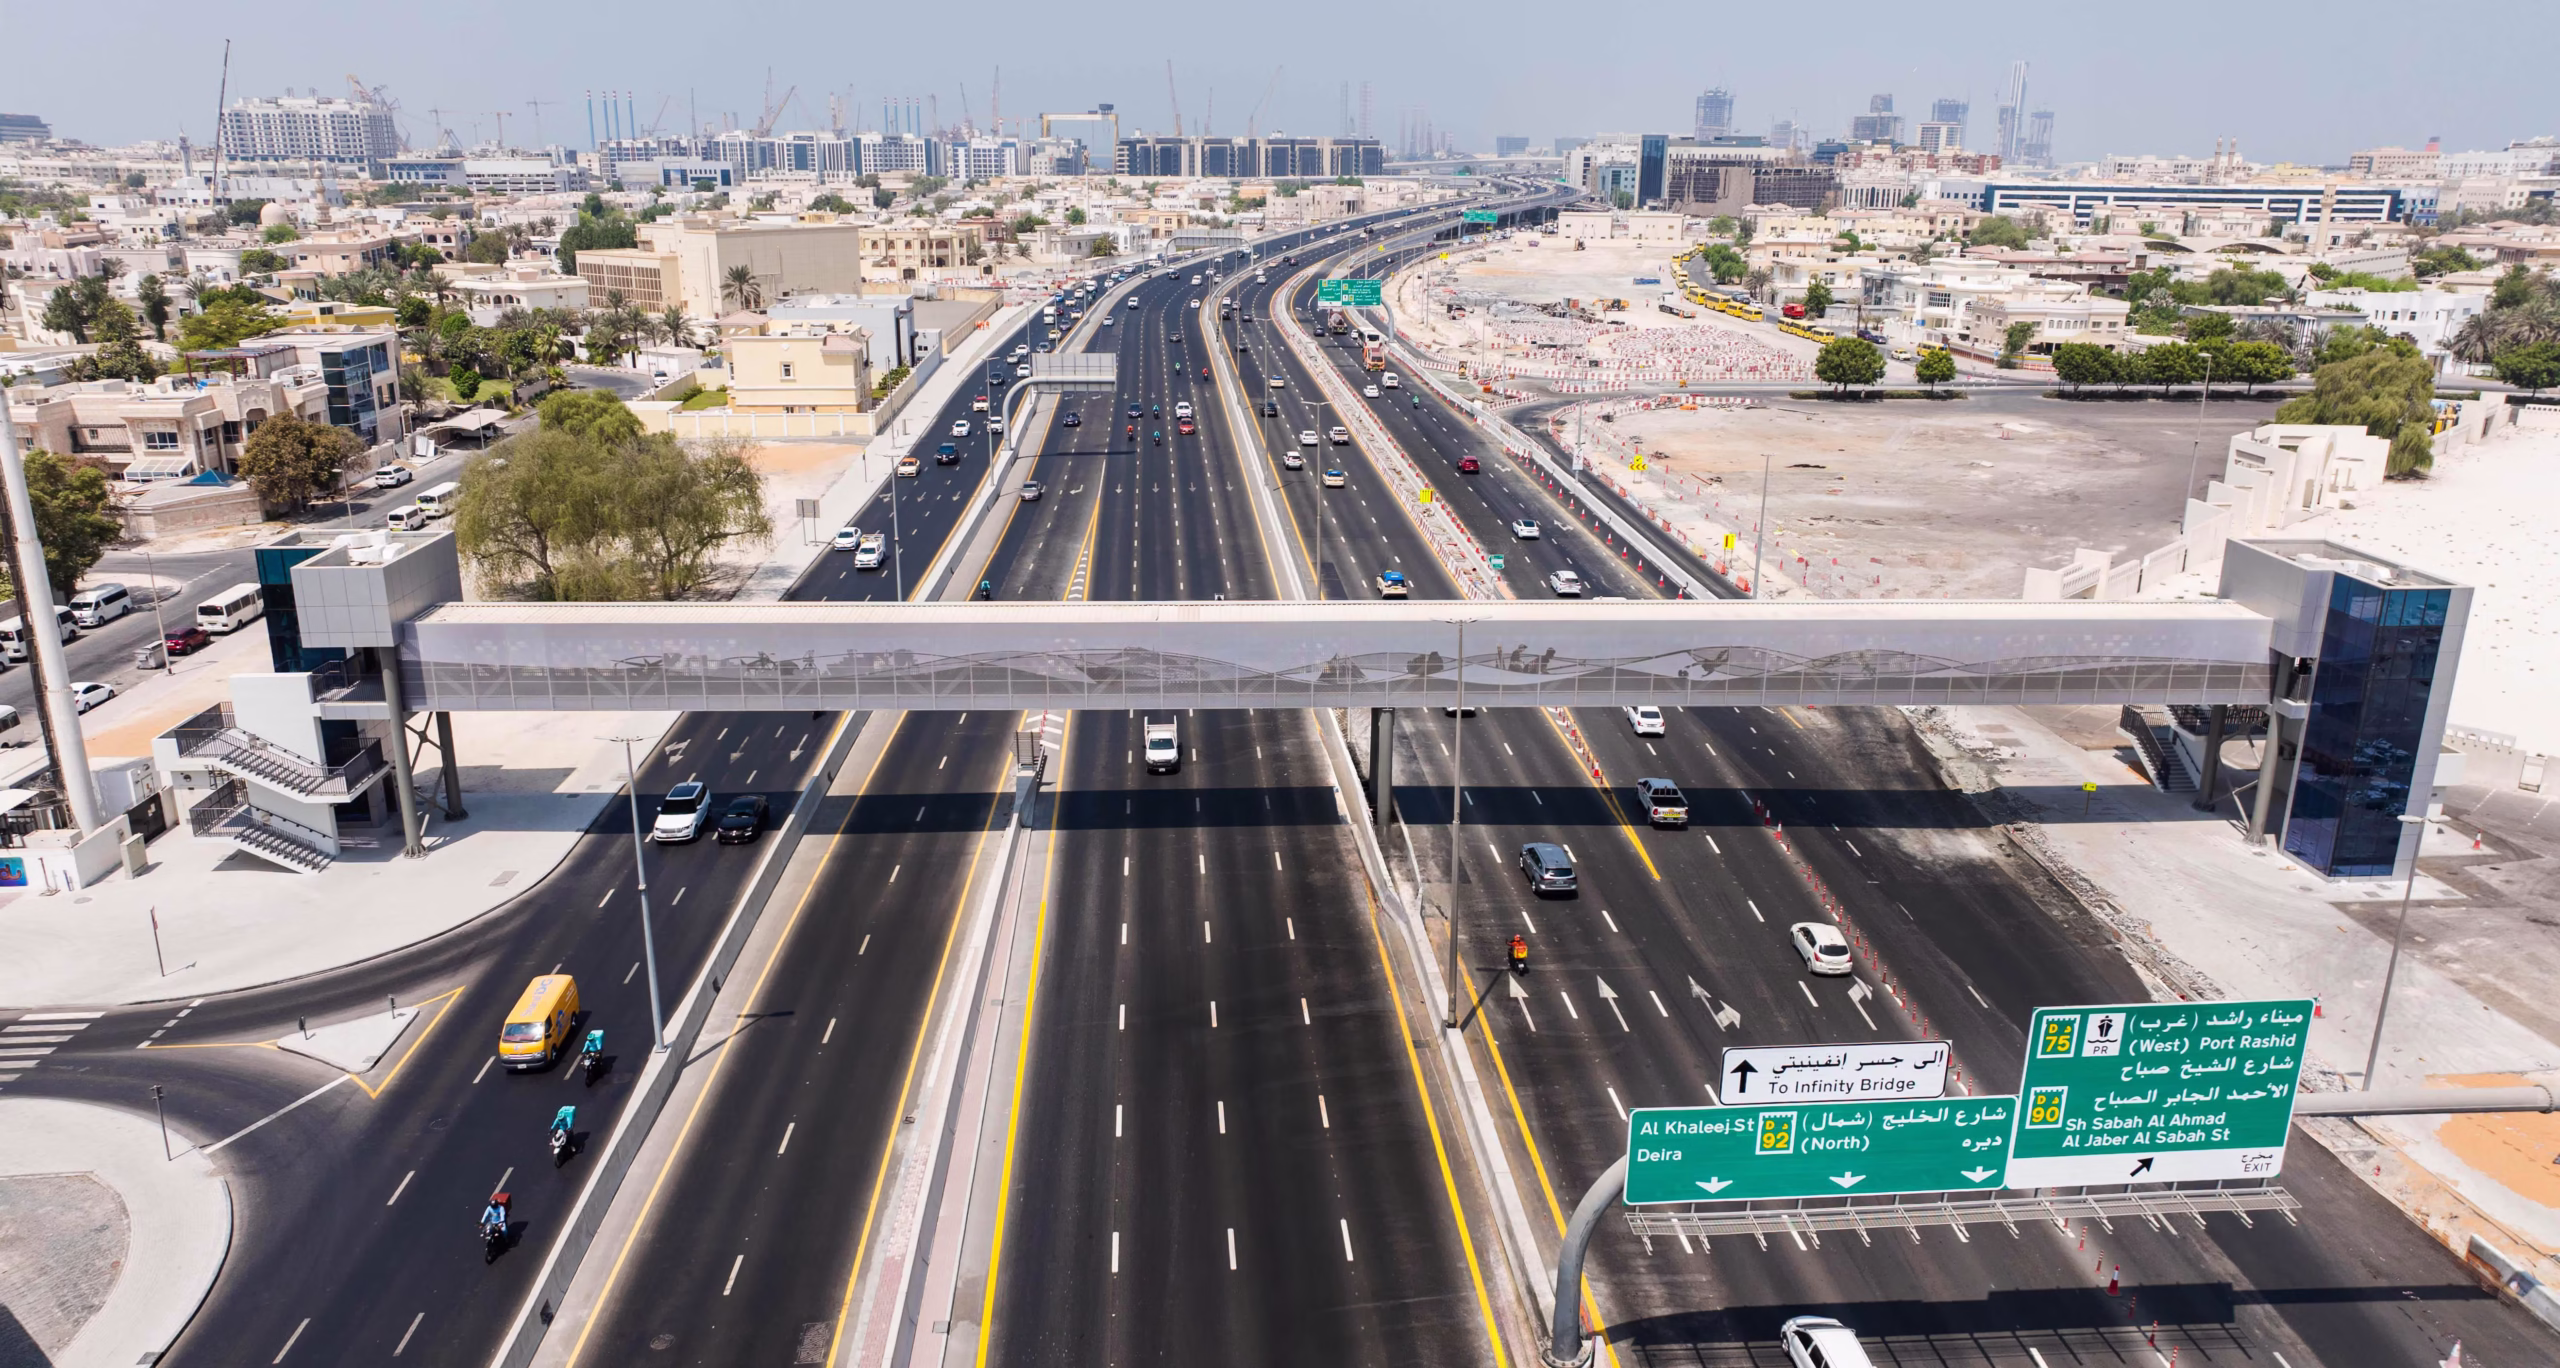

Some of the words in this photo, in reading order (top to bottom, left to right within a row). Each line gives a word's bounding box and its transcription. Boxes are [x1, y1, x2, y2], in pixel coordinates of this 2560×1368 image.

[2206, 1010, 2252, 1029] راشد
[2261, 1009, 2303, 1023] ميناء
[2046, 1035, 2070, 1052] 75
[2129, 1037, 2189, 1056] (West)
[2200, 1036, 2235, 1049] Port
[2240, 1033, 2296, 1048] Rashid
[1856, 1057, 1903, 1071] جسر
[2121, 1062, 2170, 1082] صباح
[2181, 1056, 2236, 1079] الشيخ
[2243, 1056, 2294, 1076] شارع
[1769, 1082, 1788, 1094] To
[1795, 1080, 1854, 1094] Infinity
[1861, 1078, 1915, 1092] Bridge
[2094, 1089, 2157, 1112] الصباح
[2163, 1086, 2220, 1107] الجابر
[1883, 1107, 1948, 1130] الخليج
[1955, 1106, 2006, 1126] شارع
[2031, 1106, 2059, 1123] 90
[2066, 1118, 2086, 1131] Sh
[2092, 1116, 2142, 1130] Sabah
[2148, 1114, 2164, 1127] Al
[2169, 1112, 2226, 1126] Ahmad
[1640, 1122, 1658, 1135] Al
[1665, 1119, 1730, 1134] Khaleej
[1733, 1118, 1754, 1132] St
[1763, 1132, 1789, 1149] 92
[1801, 1135, 1870, 1154] (North)
[2062, 1135, 2080, 1147] Al
[2084, 1133, 2129, 1147] Jaber
[2133, 1132, 2150, 1144] Al
[2155, 1129, 2206, 1143] Sabah
[2211, 1128, 2230, 1141] St
[1637, 1148, 1682, 1162] Deira
[2244, 1163, 2270, 1172] EXIT
